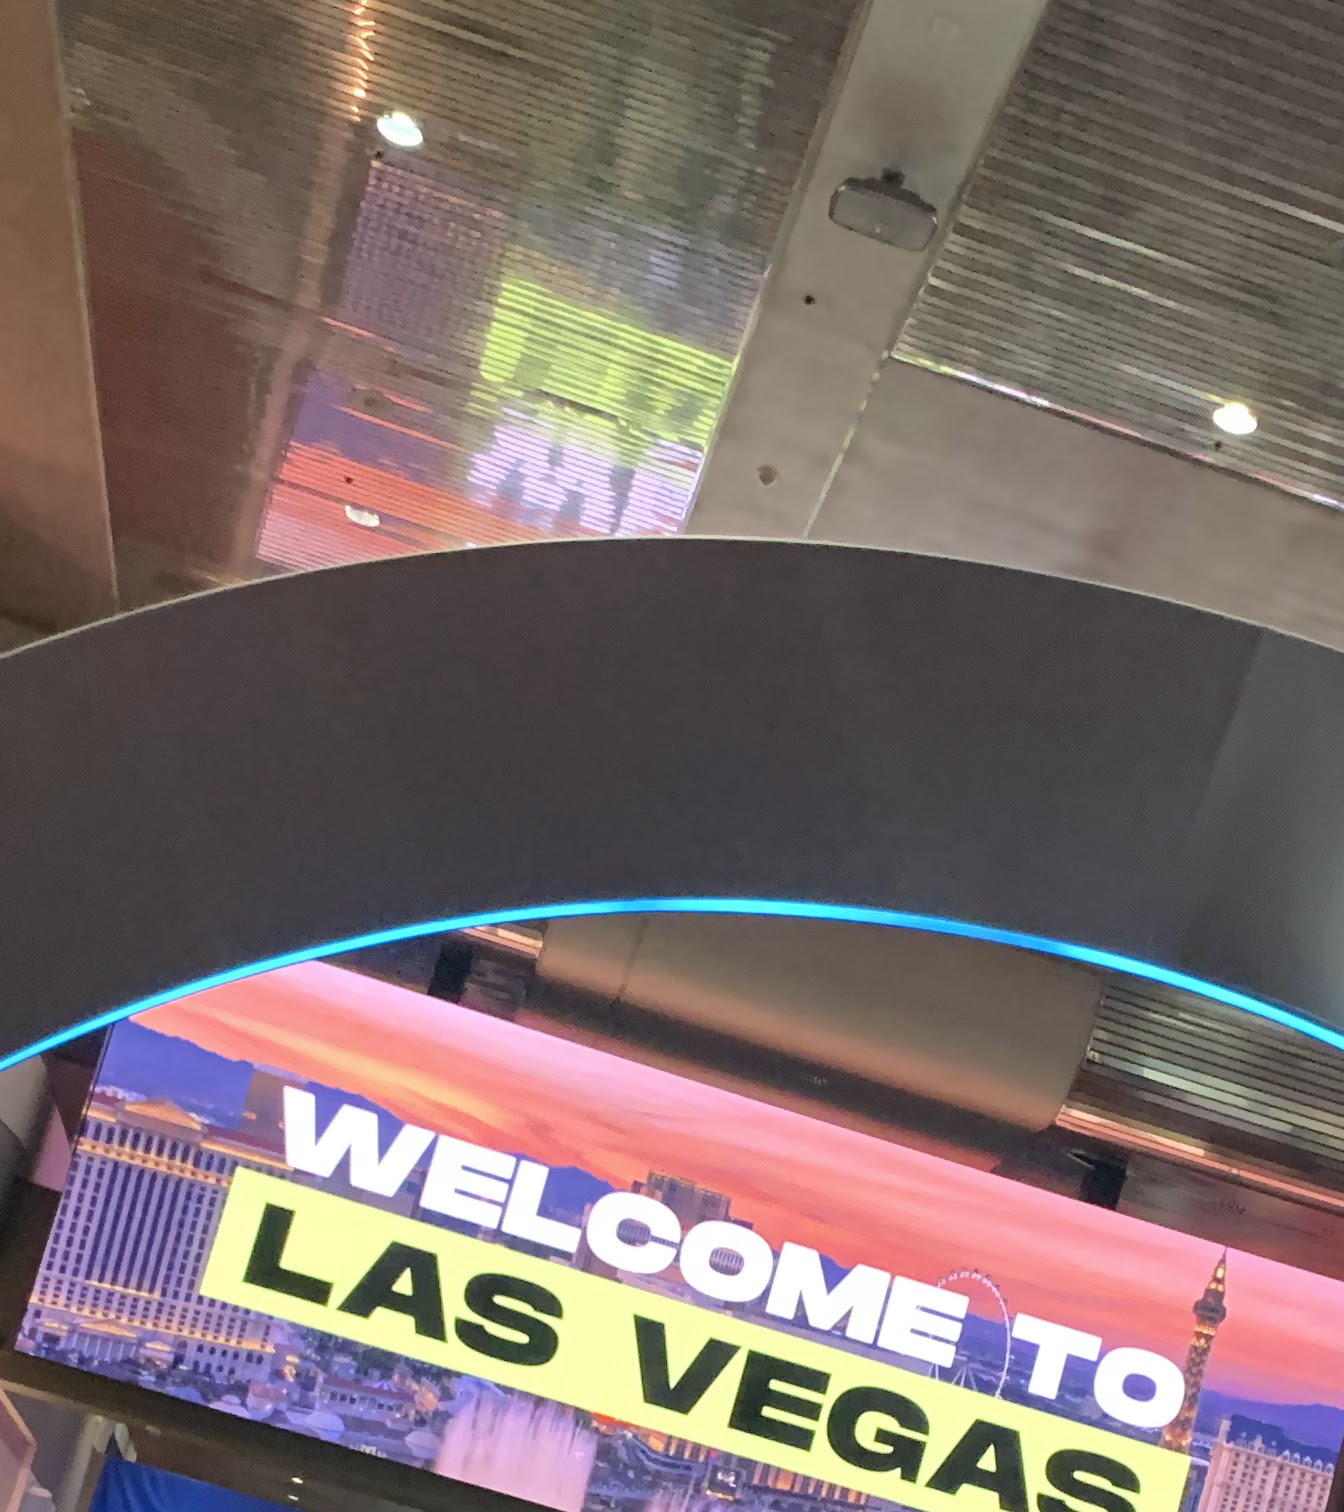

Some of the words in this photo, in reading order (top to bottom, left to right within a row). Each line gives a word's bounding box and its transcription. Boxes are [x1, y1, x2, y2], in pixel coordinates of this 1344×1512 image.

[242, 1206, 563, 1367] LAS
[280, 1084, 969, 1372] WELCOME
[1010, 1313, 1187, 1431] TO
